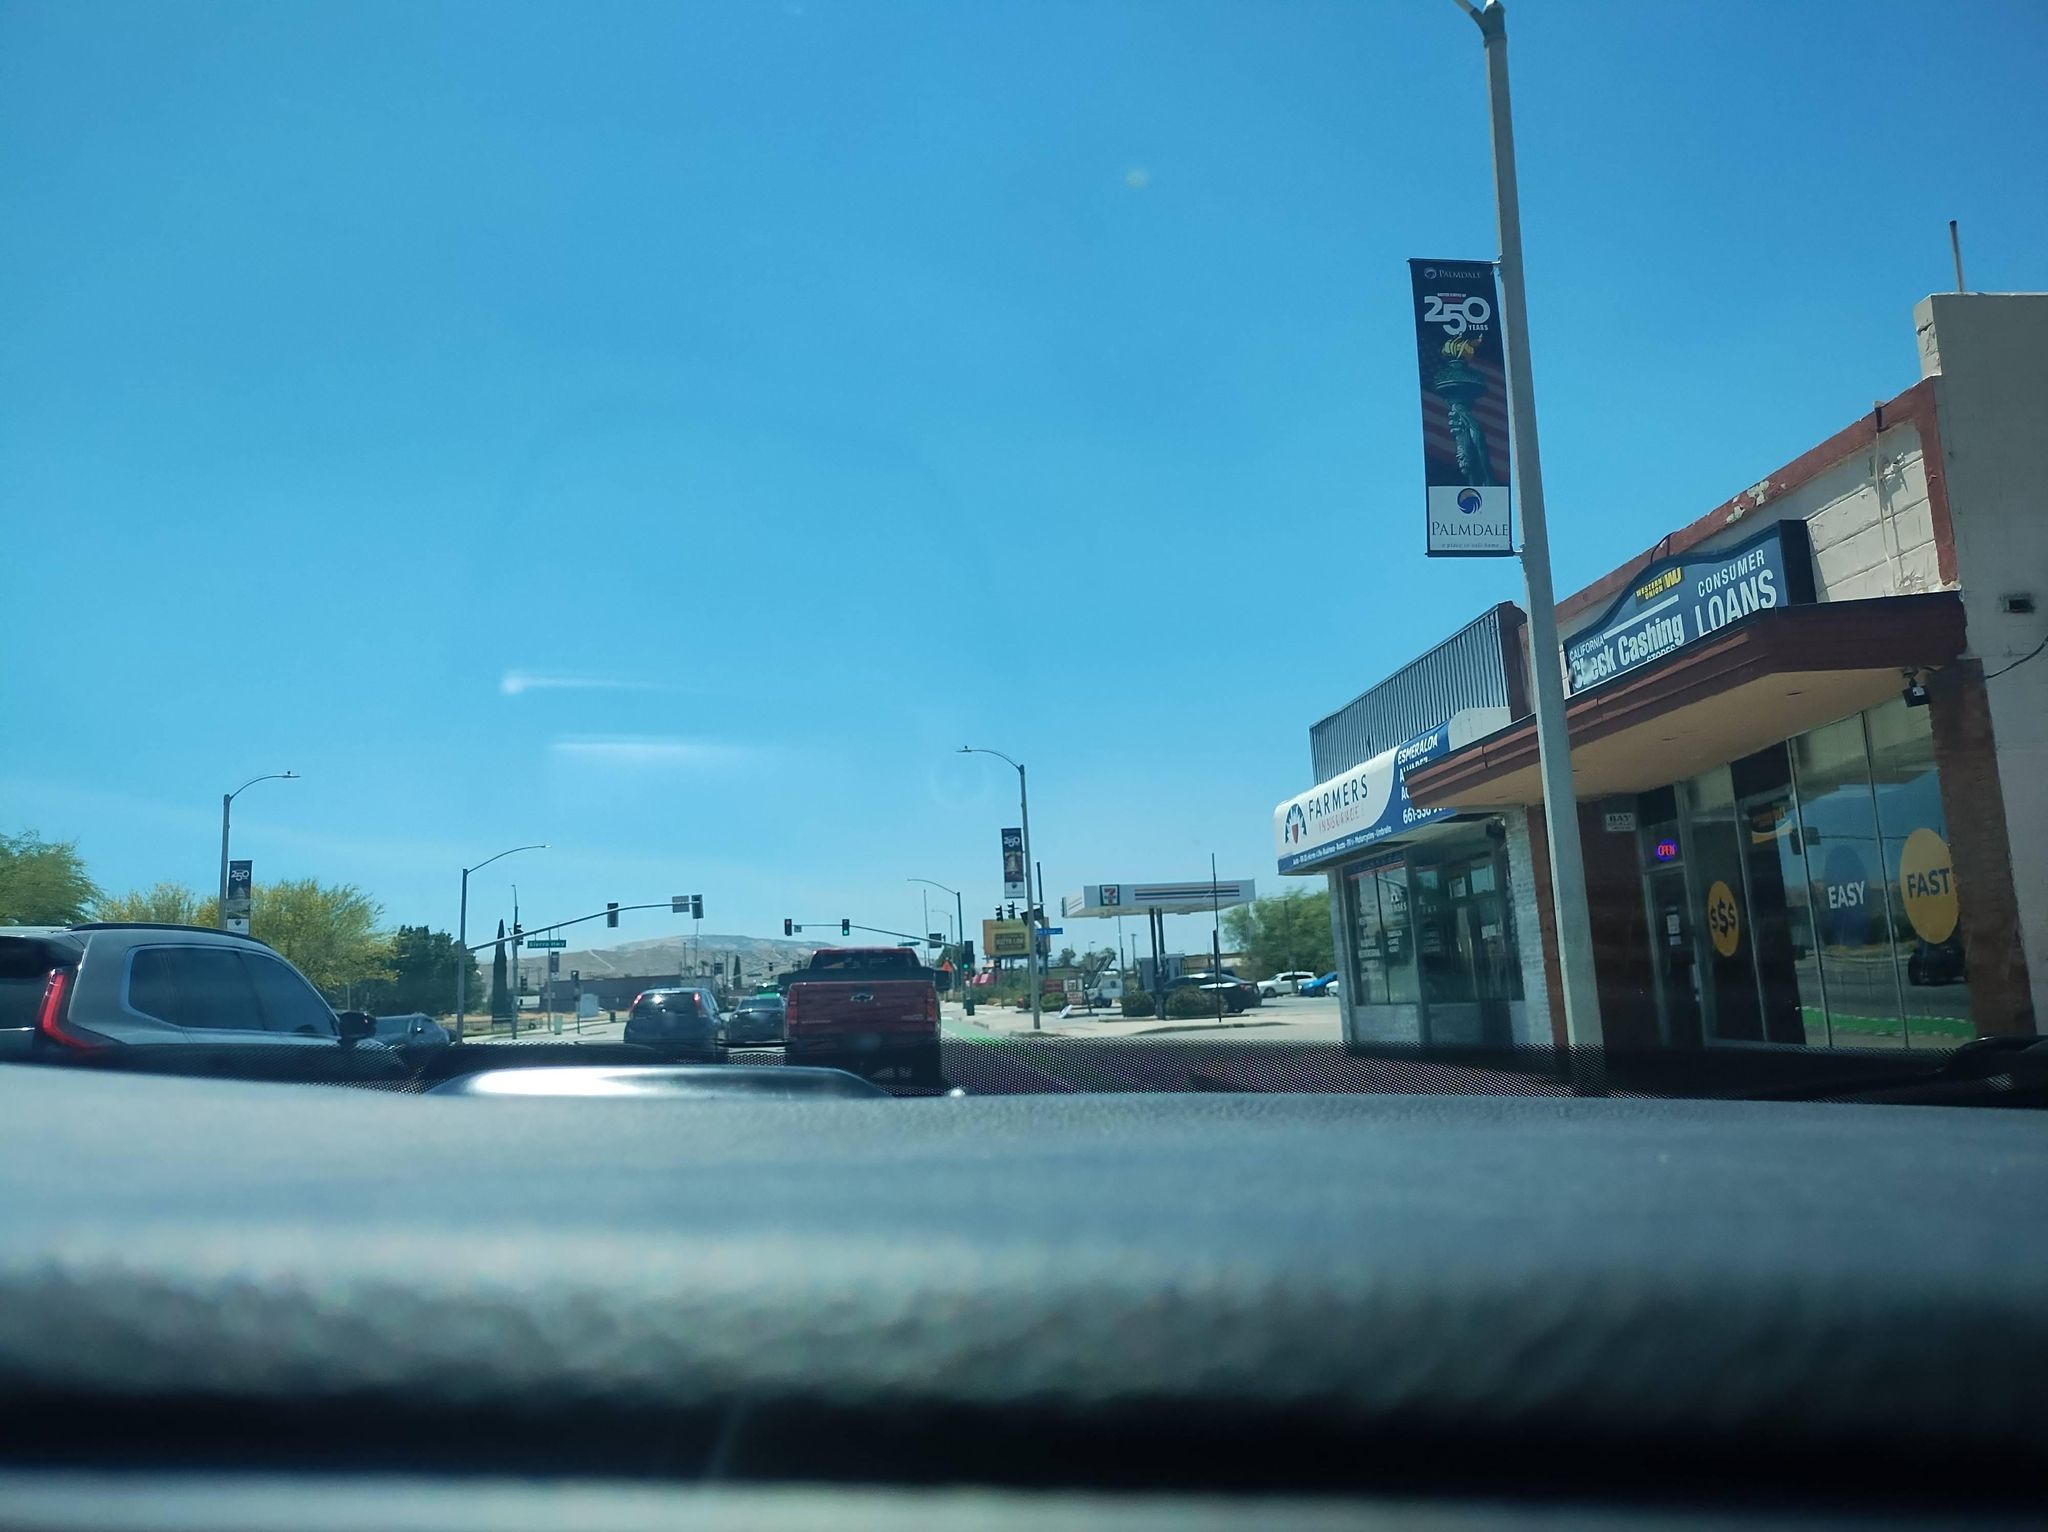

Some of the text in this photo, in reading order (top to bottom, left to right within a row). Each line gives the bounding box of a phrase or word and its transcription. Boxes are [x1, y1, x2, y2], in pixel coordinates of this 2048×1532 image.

[1424, 295, 1491, 336] 250
[1432, 521, 1509, 537] PALMDALE
[1698, 549, 1765, 598] CONSUMER
[1695, 569, 1777, 638] LOANS
[1569, 634, 1605, 662] CALIFORNIA
[1617, 614, 1685, 667] Cashing
[1397, 732, 1439, 766] ESMERALDA
[1308, 773, 1368, 822] FARMERS
[1658, 844, 1676, 856] OPEN
[231, 870, 250, 881] 250
[1906, 867, 1951, 899] FAST
[1827, 880, 1865, 909] EASY
